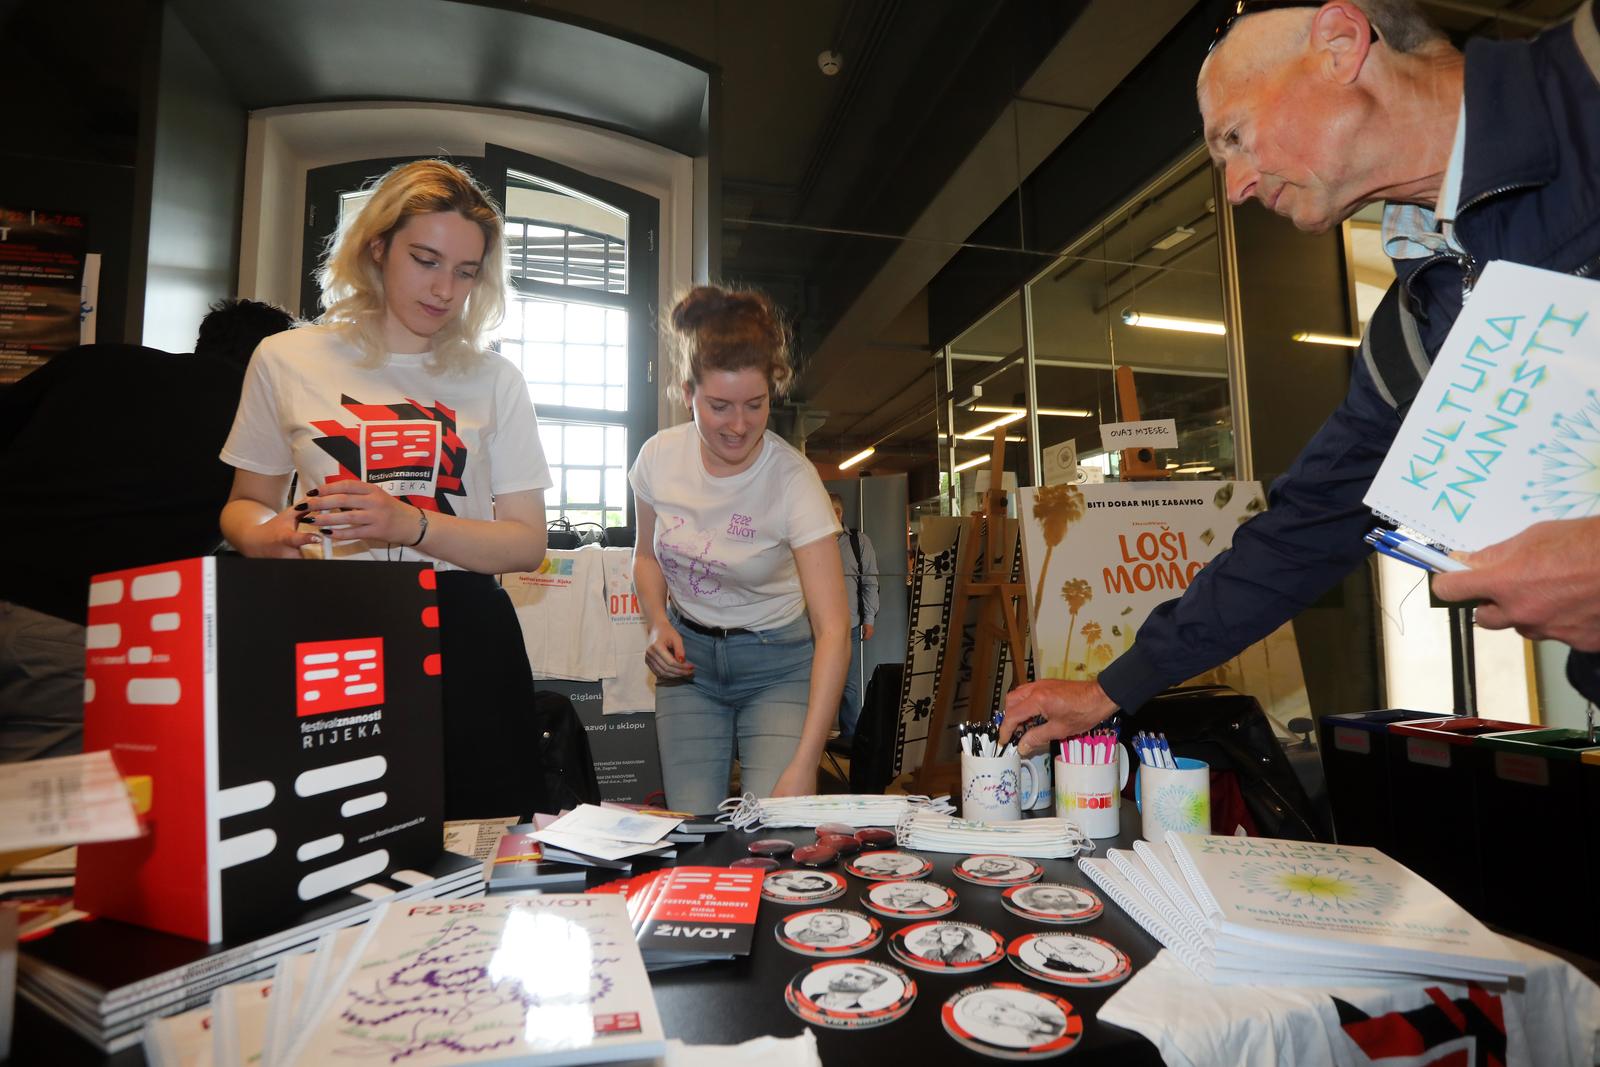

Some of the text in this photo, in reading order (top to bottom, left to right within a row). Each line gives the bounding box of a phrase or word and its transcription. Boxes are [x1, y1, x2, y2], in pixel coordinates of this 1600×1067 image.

[1401, 313, 1526, 491] KULTURA
[1432, 303, 1590, 523] ZNANOSTI
[1110, 427, 1169, 437] OVAJ MJESEC
[368, 471, 431, 481] festivalznanosti
[1087, 498, 1204, 509] BITI DOBAR NIJE ZABAVNO
[1118, 526, 1188, 563] LOŠI
[1103, 561, 1210, 594] MOMC
[301, 709, 383, 734] festivalznanosti
[616, 721, 646, 731] sklopu
[302, 722, 382, 750] RIJEKA
[654, 924, 737, 940] ŽIVOT
